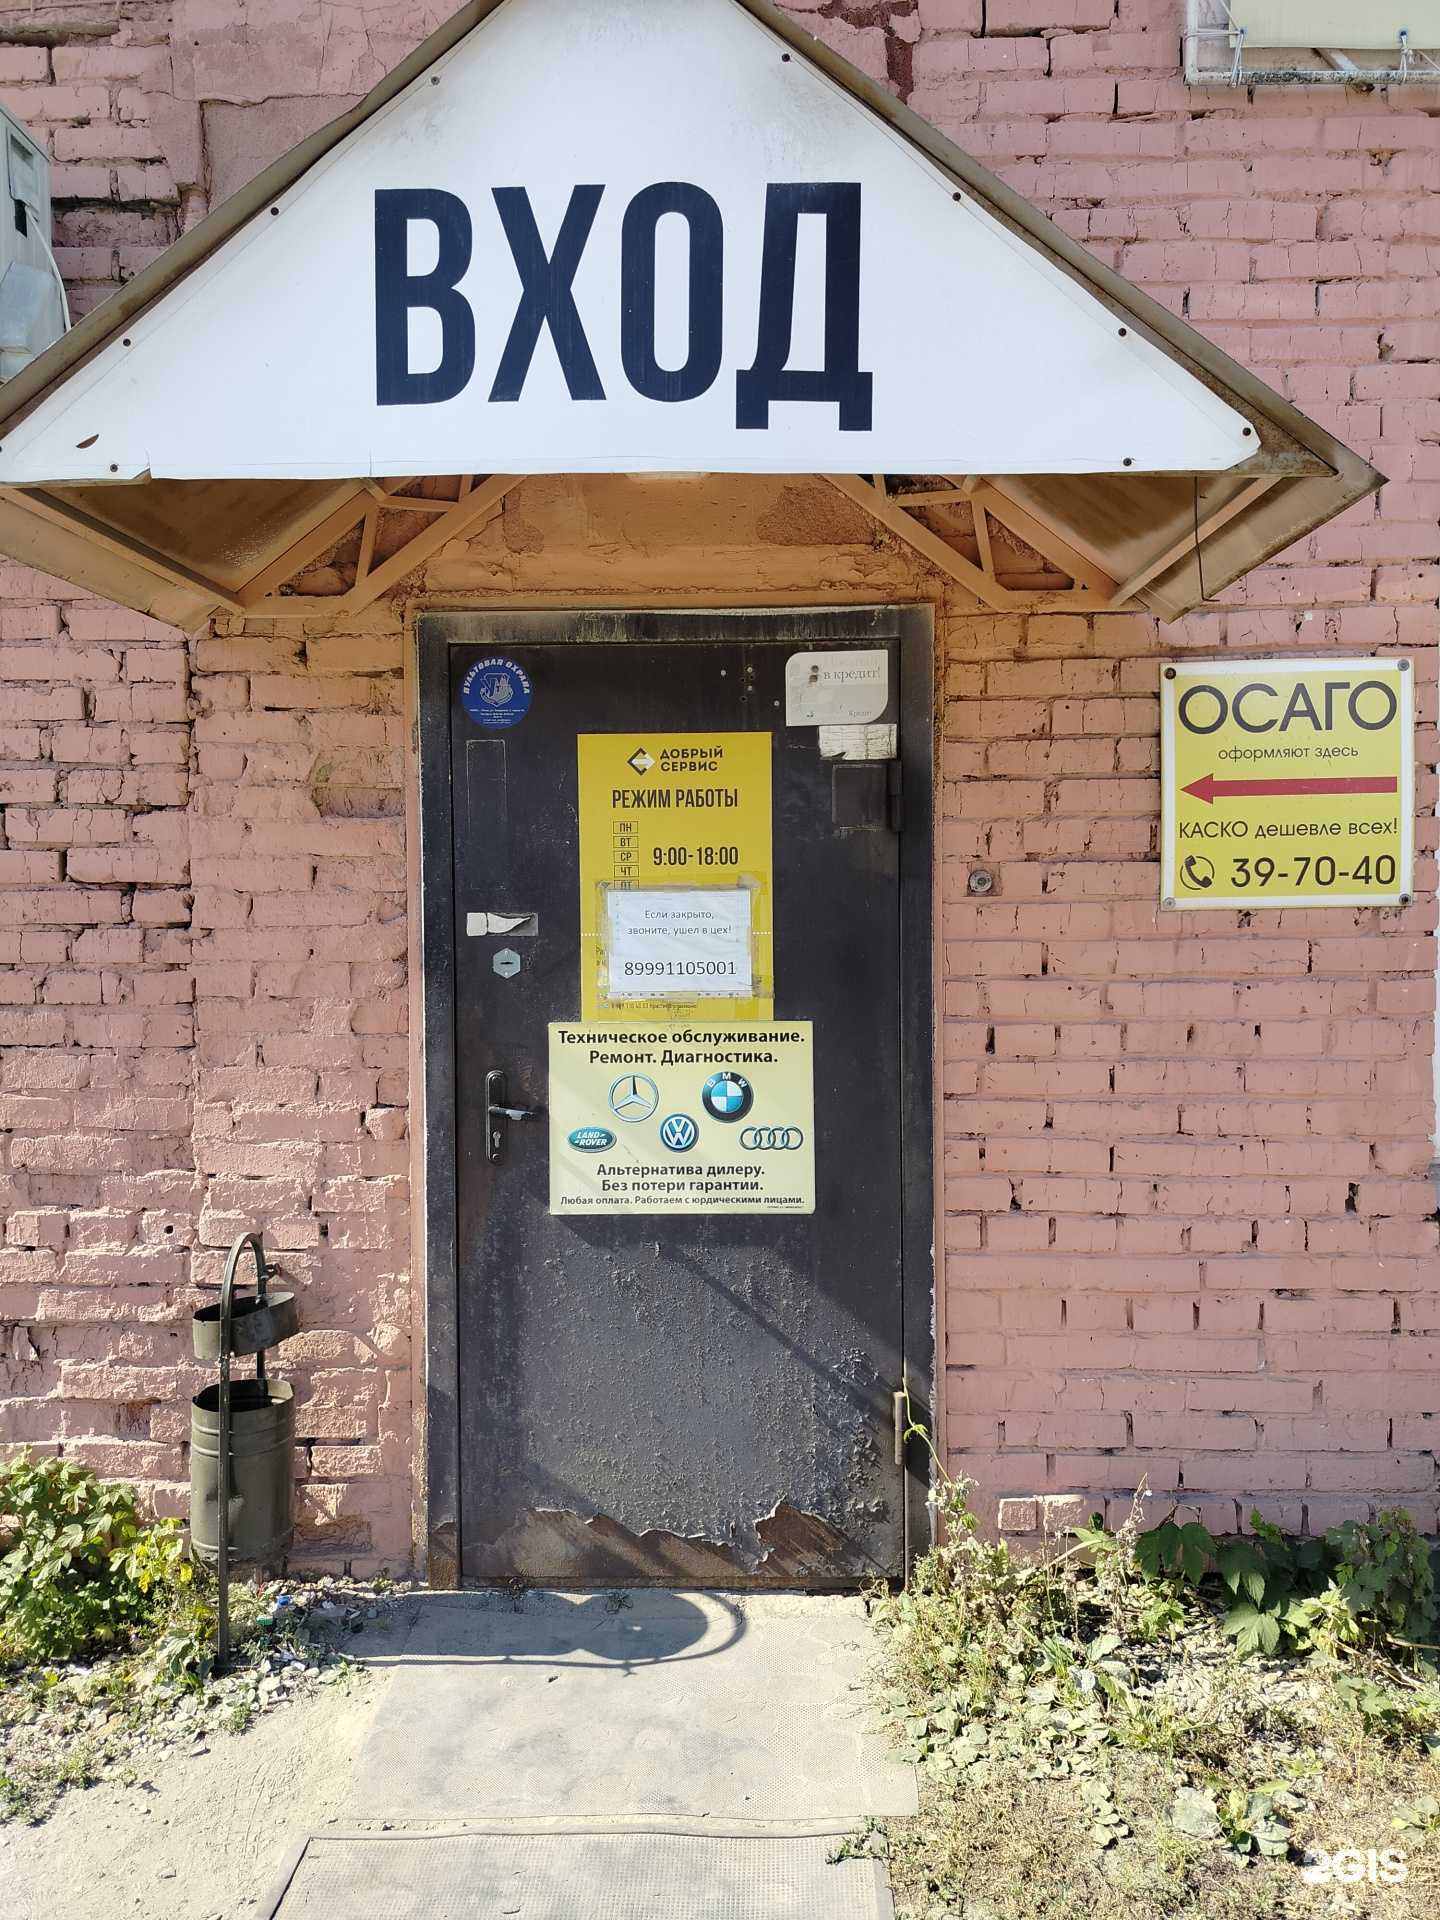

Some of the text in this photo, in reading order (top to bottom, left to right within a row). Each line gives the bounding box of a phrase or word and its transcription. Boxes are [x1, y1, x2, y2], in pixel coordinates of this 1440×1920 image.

[374, 181, 873, 432] ВХОД
[463, 658, 531, 694] ПУЛЬТОВАЯ ОХРАНА
[823, 672, 830, 680] в
[1178, 680, 1398, 735] ОСАГО
[660, 745, 723, 759] ДОБРЫЙ
[1218, 745, 1359, 763] оформляют здесь
[660, 761, 718, 772] СЕРВИС
[612, 788, 738, 809] РЕЖИМ РАБОТЫ
[619, 822, 632, 832] ПН
[1179, 818, 1398, 839] КАСКО дешевле всех!
[620, 837, 631, 847] ВТ
[620, 852, 632, 860] СР
[653, 847, 738, 866] 9:00-18:00
[620, 866, 632, 876] ЧТ
[1231, 855, 1396, 887] 39-70-40
[645, 910, 714, 920] Если закрыто,
[627, 927, 670, 936] звоните,
[673, 926, 699, 937] ушел
[710, 926, 731, 936] цех!
[624, 961, 737, 976] 89991105001
[558, 1029, 805, 1046] Техническое обслуживание.
[589, 1050, 778, 1066] Ремонт. Диагностика.
[706, 1072, 748, 1088] BMW
[577, 1131, 600, 1139] LAND
[579, 1138, 607, 1146] ROVER
[597, 1164, 765, 1178] Альтернатива дилеру.
[602, 1179, 764, 1193] Без потери гарантии.
[560, 1196, 593, 1205] Любая
[634, 1195, 682, 1204] Работаем
[763, 1196, 805, 1205] лицами.
